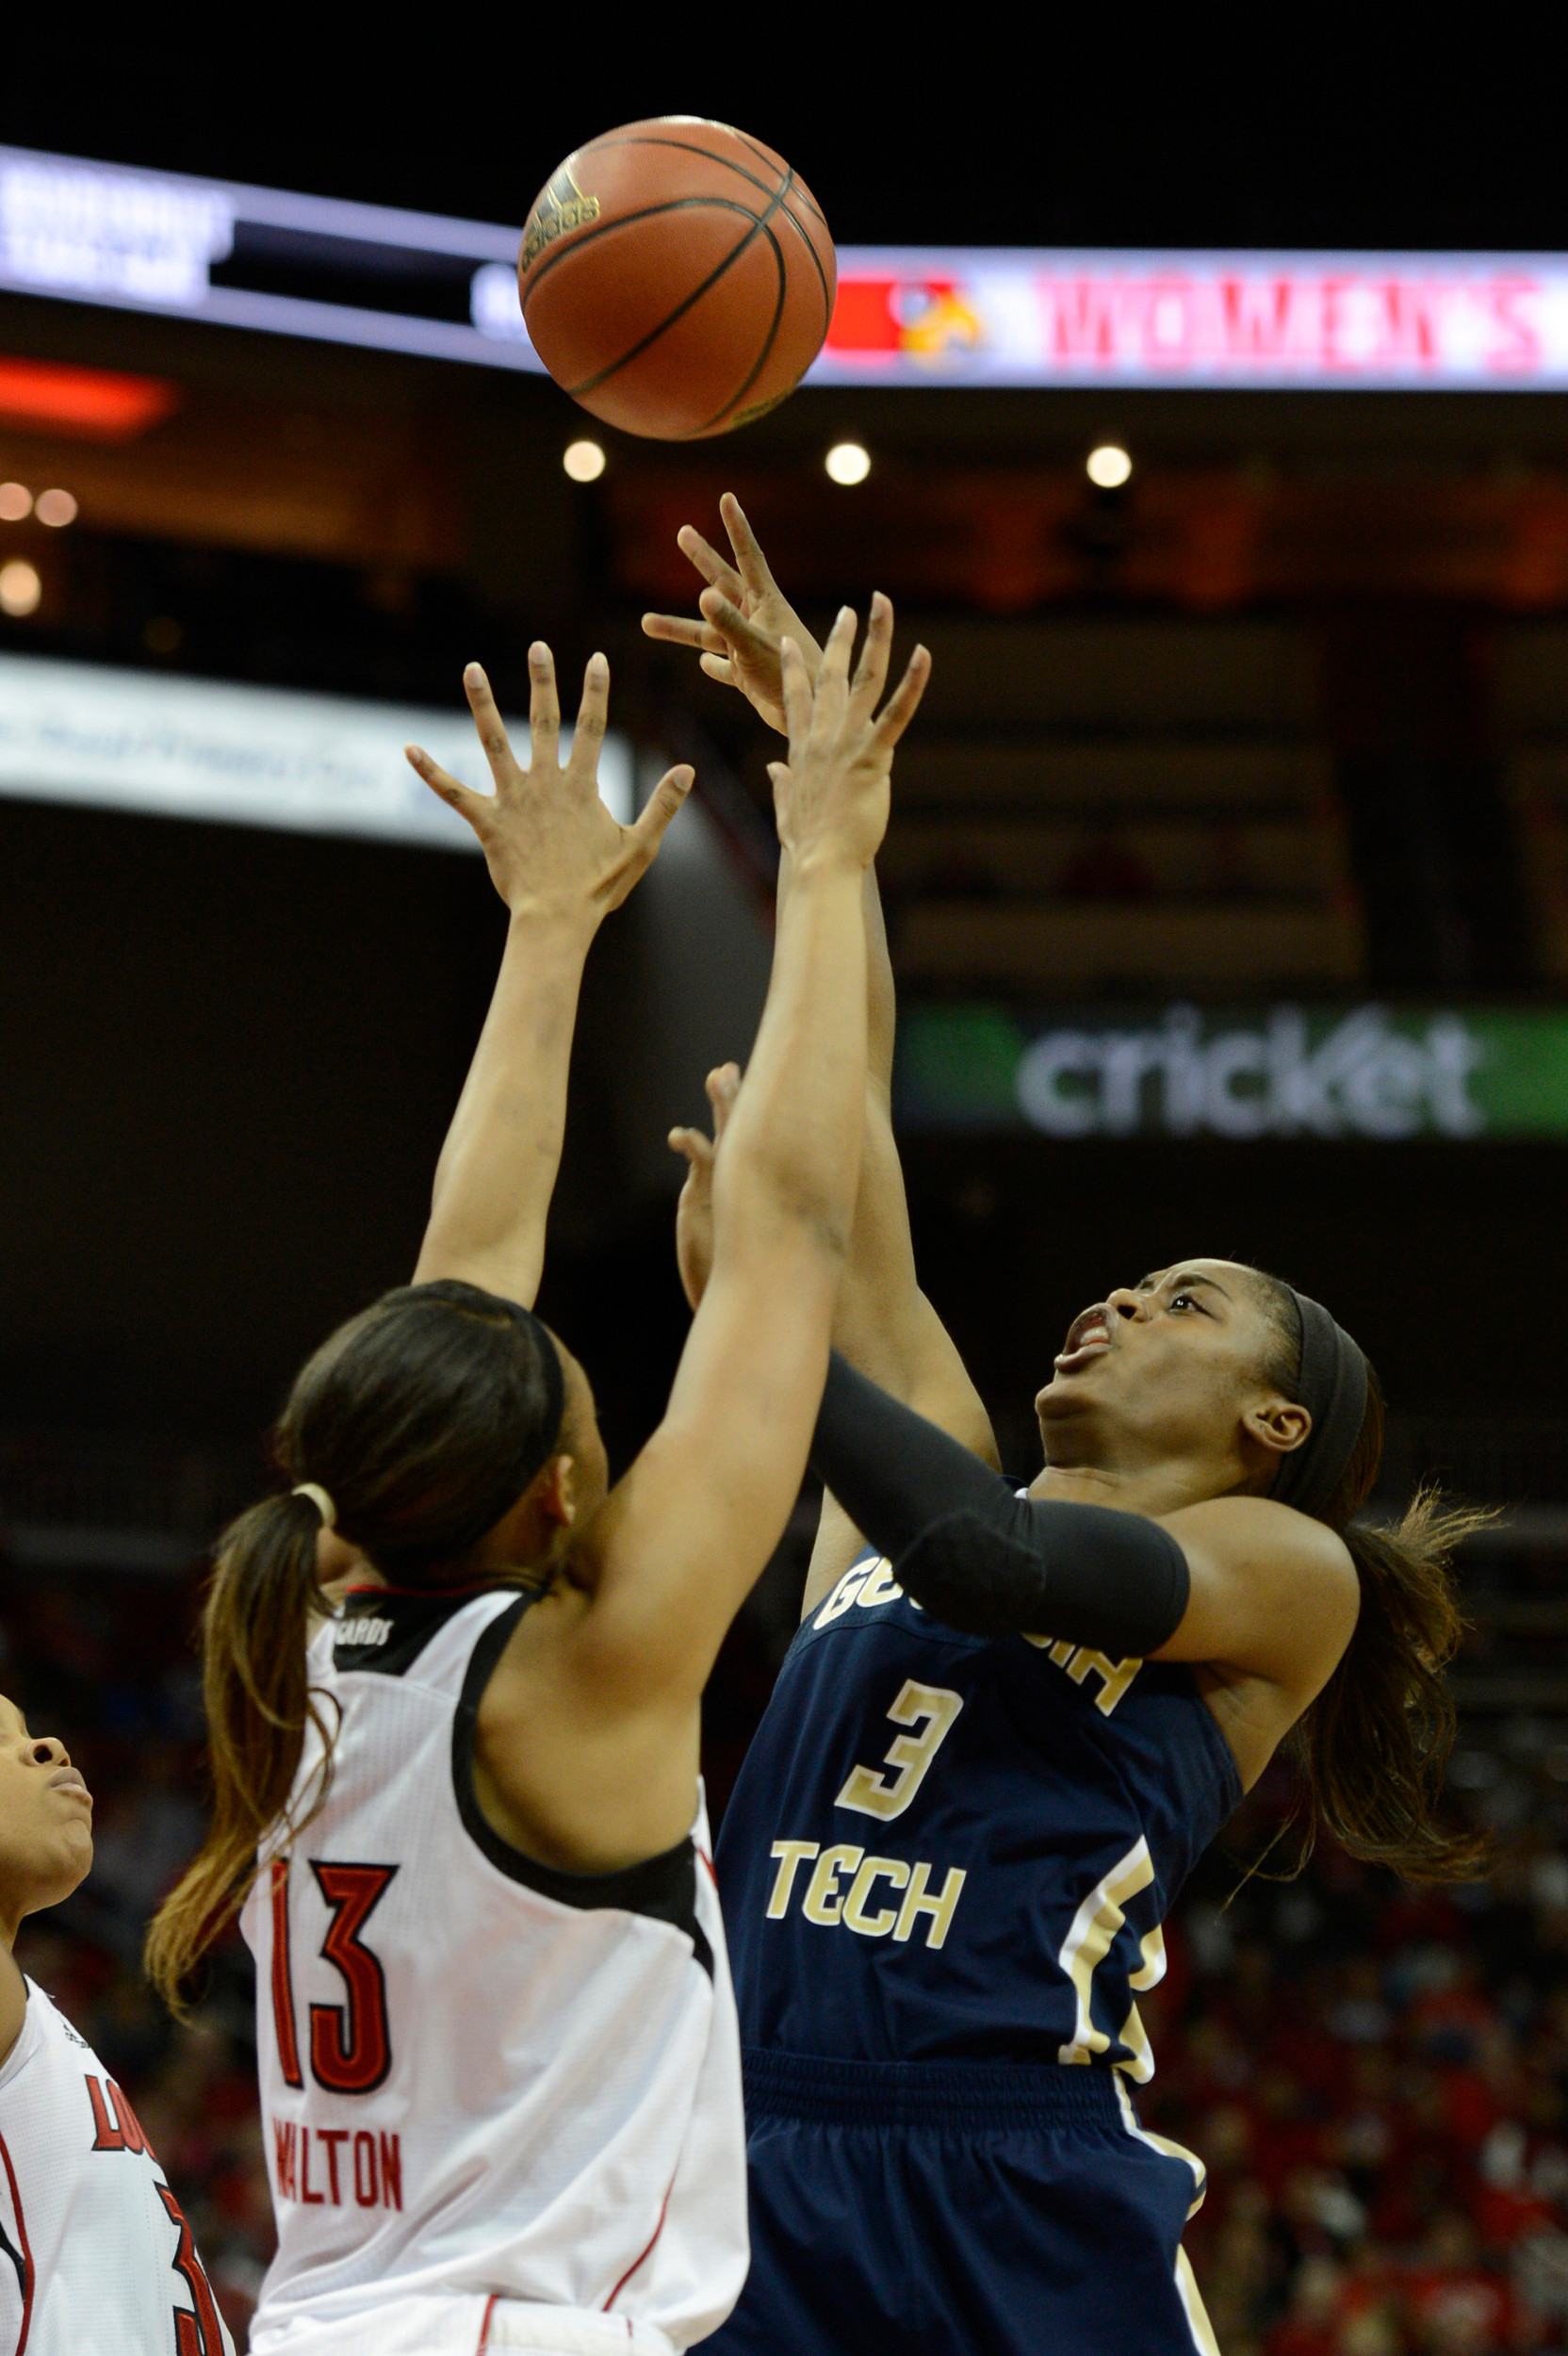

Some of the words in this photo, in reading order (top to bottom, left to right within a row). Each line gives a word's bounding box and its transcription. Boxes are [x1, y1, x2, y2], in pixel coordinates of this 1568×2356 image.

[1017, 1003, 1483, 1138] cricket
[834, 1678, 964, 1822] 3
[766, 1840, 967, 1950] TECH
[270, 1857, 400, 2096] 13
